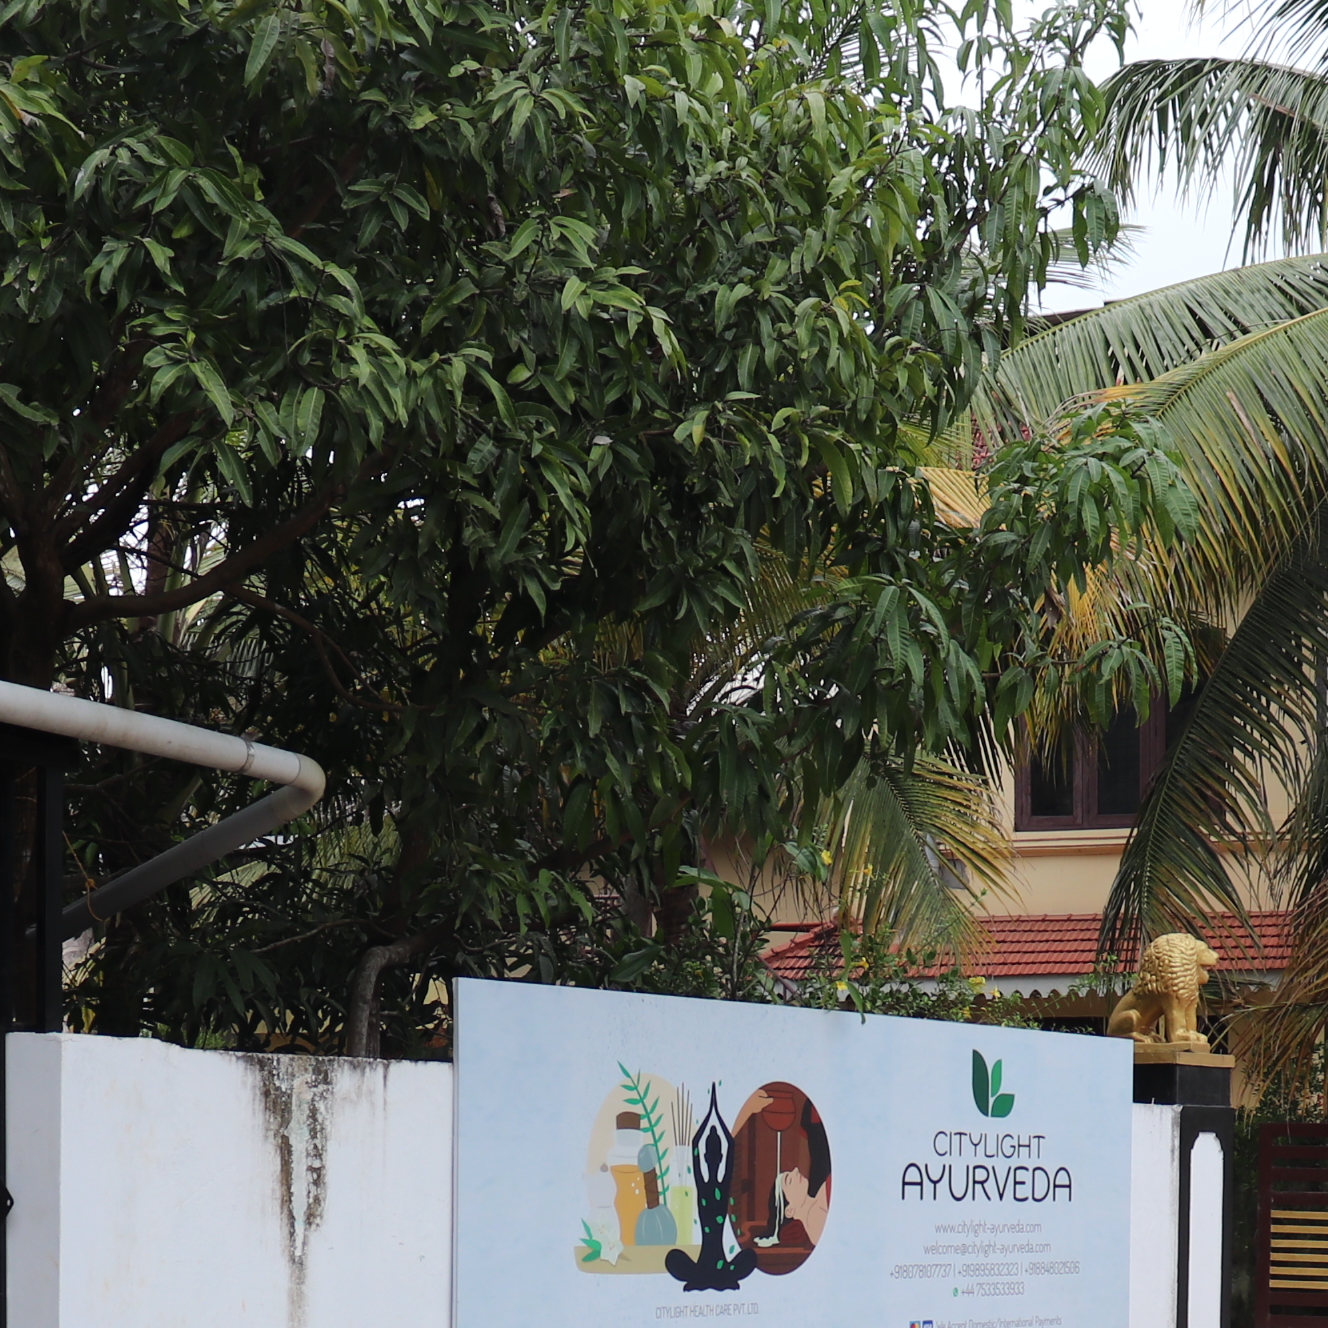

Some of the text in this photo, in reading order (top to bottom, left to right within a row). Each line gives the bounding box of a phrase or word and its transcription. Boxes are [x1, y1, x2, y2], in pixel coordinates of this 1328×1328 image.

[933, 1130, 1046, 1159] CITYLIGHT
[901, 1162, 1072, 1202] AYURVEDA
[934, 1220, 1042, 1237] www.citylight-ayurveda.com
[924, 1240, 1051, 1258] welcome@citylight-ayurveda.com
[961, 1283, 975, 1297] +44
[655, 1305, 688, 1319] CITYLIGHT
[690, 1304, 714, 1318] HEALTH
[715, 1303, 732, 1316] CARE
[1035, 1314, 1062, 1328] Payments
